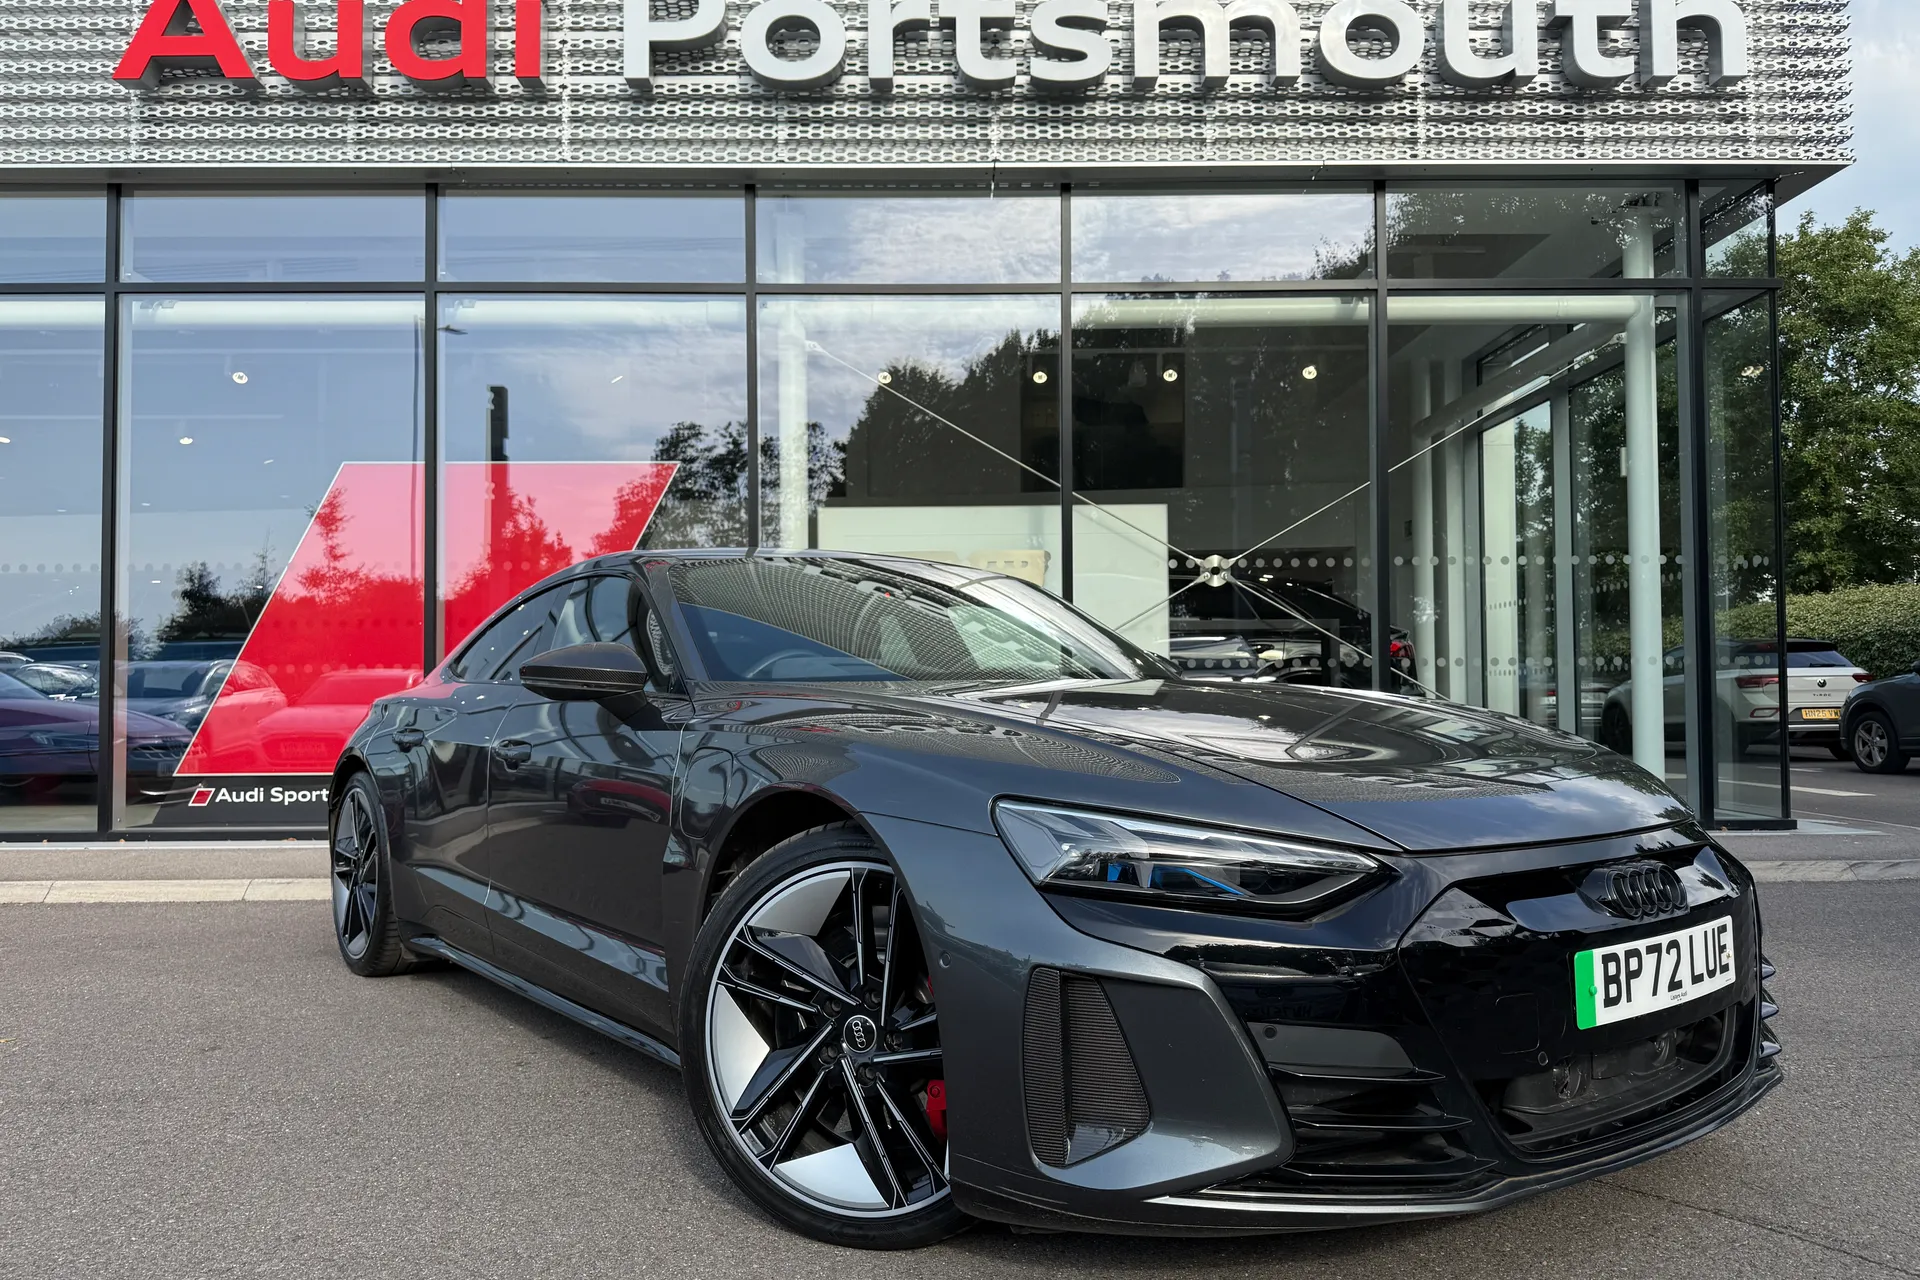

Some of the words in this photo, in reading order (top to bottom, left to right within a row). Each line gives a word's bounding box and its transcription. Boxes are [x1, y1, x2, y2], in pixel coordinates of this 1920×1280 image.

[112, 0, 542, 83] Audi
[624, 0, 1748, 83] Portsmouth
[1804, 709, 1827, 718] HN25
[1828, 709, 1841, 718] VW
[215, 787, 264, 802] Audi
[270, 787, 330, 805] Sport
[1601, 939, 1683, 1008] BP72
[1688, 923, 1730, 985] LUE
